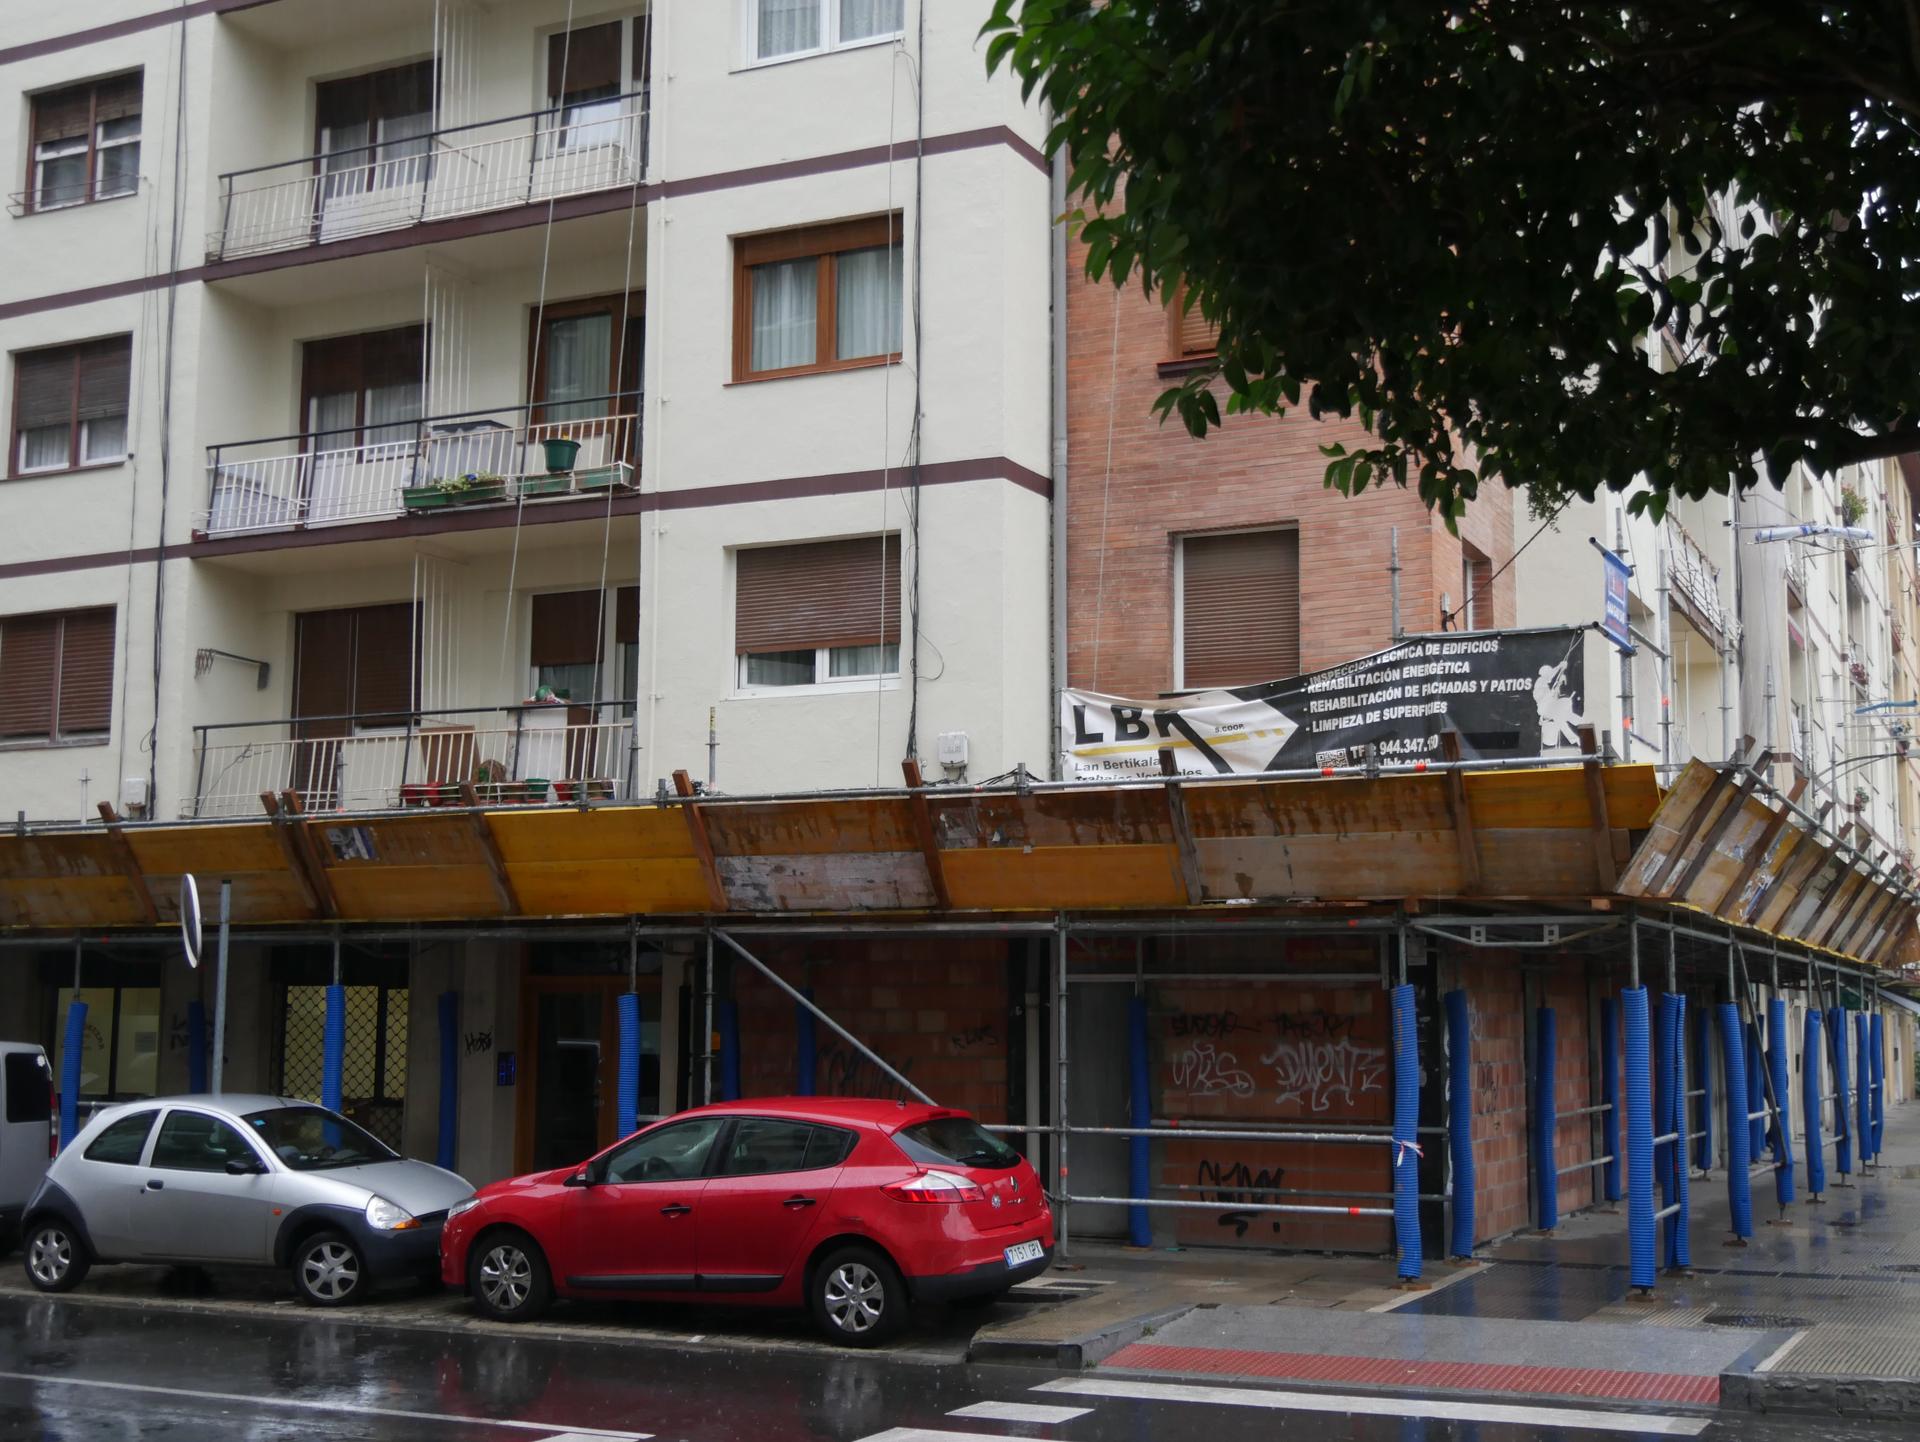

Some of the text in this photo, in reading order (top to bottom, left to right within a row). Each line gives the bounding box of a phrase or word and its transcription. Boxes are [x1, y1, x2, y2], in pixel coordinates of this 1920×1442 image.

[1425, 644, 1440, 656] DE
[1442, 640, 1498, 655] EDIFICIOS
[1307, 660, 1470, 694] REHABILITACIÓN ENERGÉTICA
[1310, 678, 1532, 713] REHABILITACIÓN DE FACHADAS Y PATIOS
[1312, 713, 1364, 733] LIMPIEZA
[1366, 710, 1381, 724] DE
[1073, 703, 1234, 774] LBK
[1075, 756, 1161, 772] Lan Bertikala
